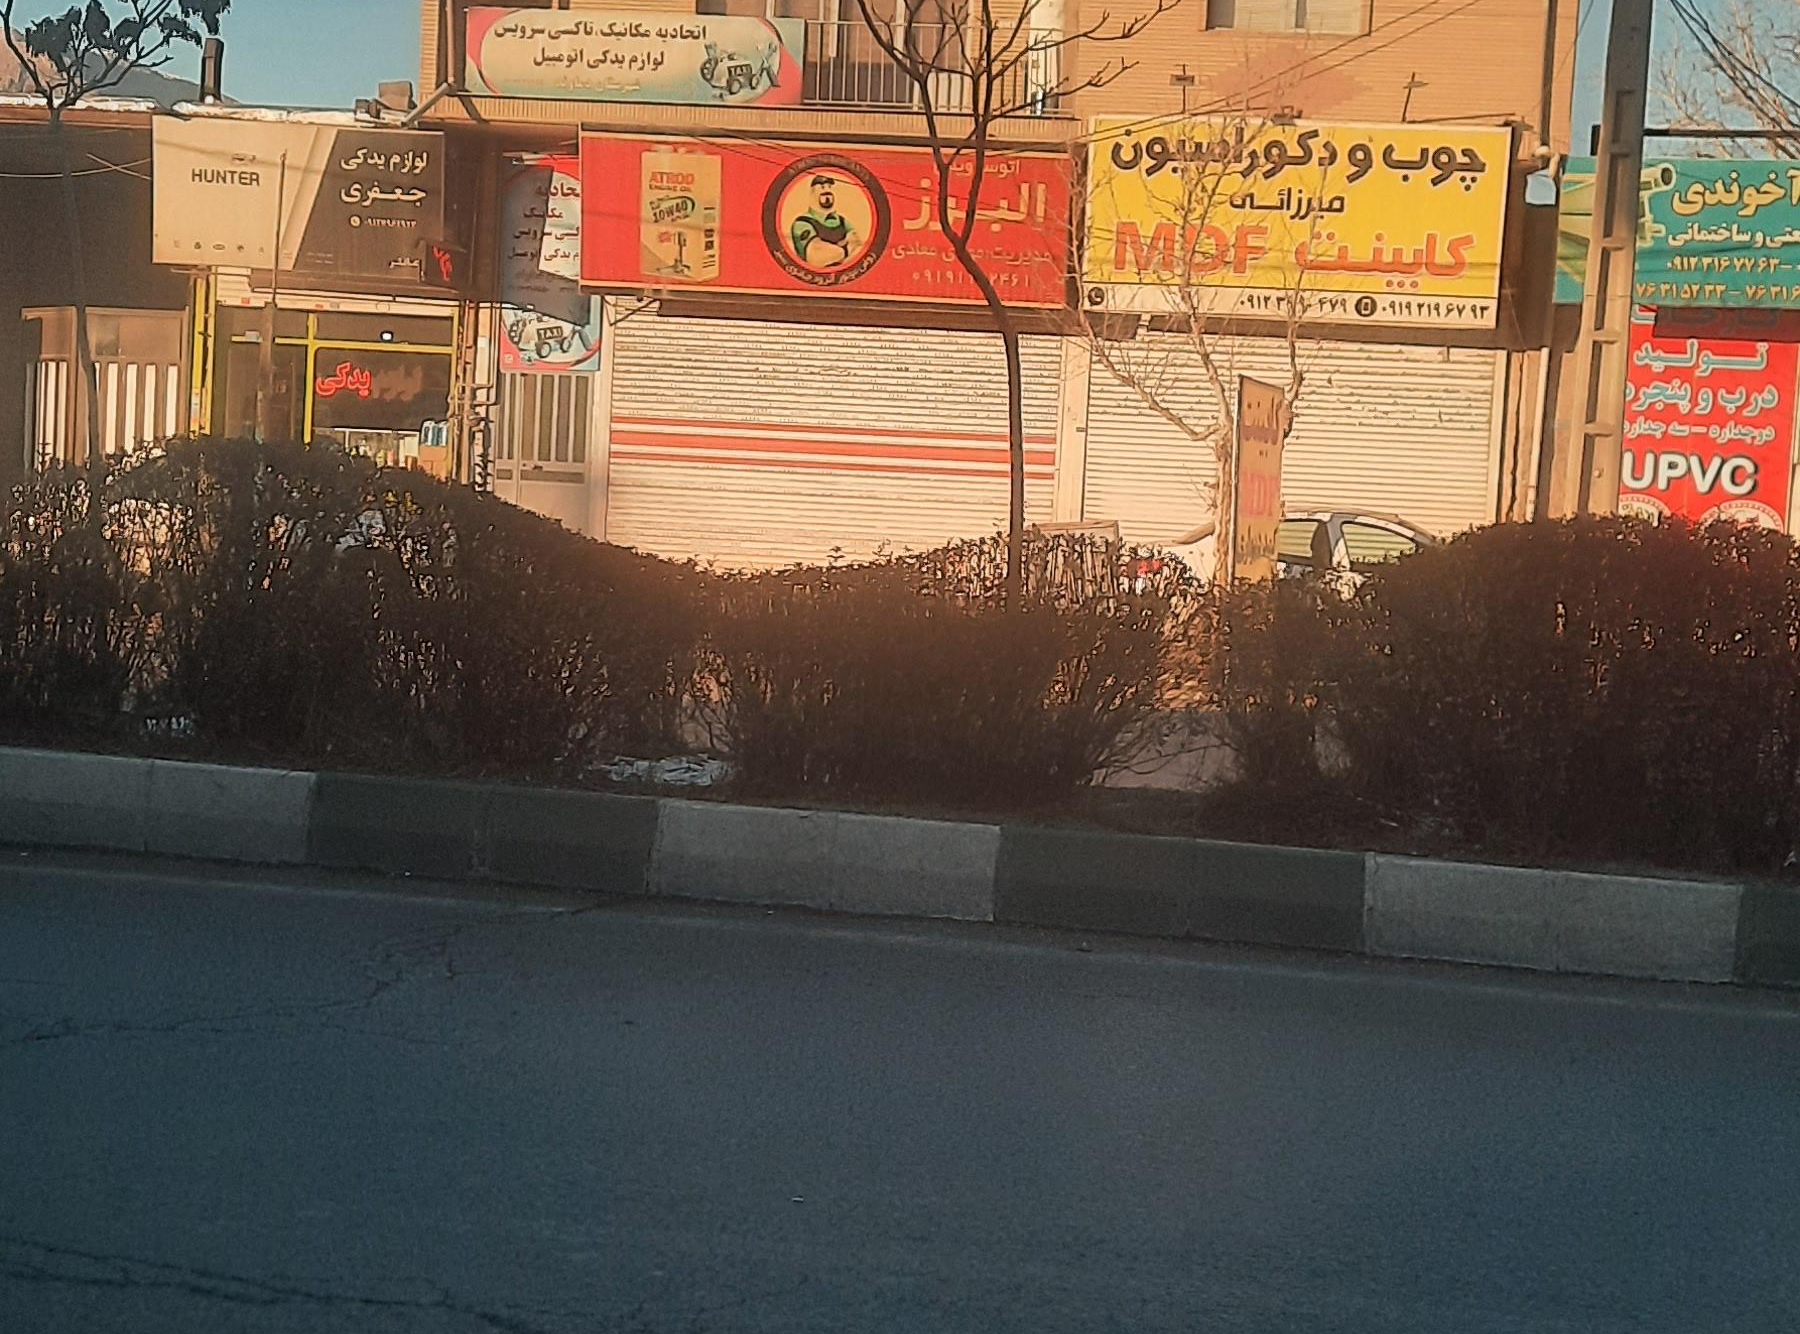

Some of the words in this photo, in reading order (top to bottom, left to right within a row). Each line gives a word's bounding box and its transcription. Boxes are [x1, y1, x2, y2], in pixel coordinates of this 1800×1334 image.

[494, 21, 545, 40] سرویس
[547, 21, 594, 41] تاکسی
[655, 23, 707, 42] اتحادیه
[533, 47, 584, 69] اتومبیل
[588, 49, 626, 70] یدکی
[629, 51, 665, 71] لوازم
[340, 147, 386, 170] یدکی
[390, 150, 428, 174] لوازم
[1110, 128, 1338, 181] دکوراسیون
[1345, 141, 1374, 183] و
[1381, 141, 1487, 192] چوب
[191, 168, 260, 187] HUNTER
[340, 180, 427, 207] جعفری
[903, 178, 1047, 232] البرز
[1113, 220, 1269, 275] MDF
[1667, 221, 1752, 248] ساختمانی
[1752, 230, 1764, 249] و
[1294, 231, 1475, 289] کابینت
[1633, 338, 1770, 376] تولید
[315, 361, 372, 400] یدکی
[1694, 385, 1714, 413] و
[1718, 383, 1780, 416] درب
[1622, 450, 1758, 497] UPVC
